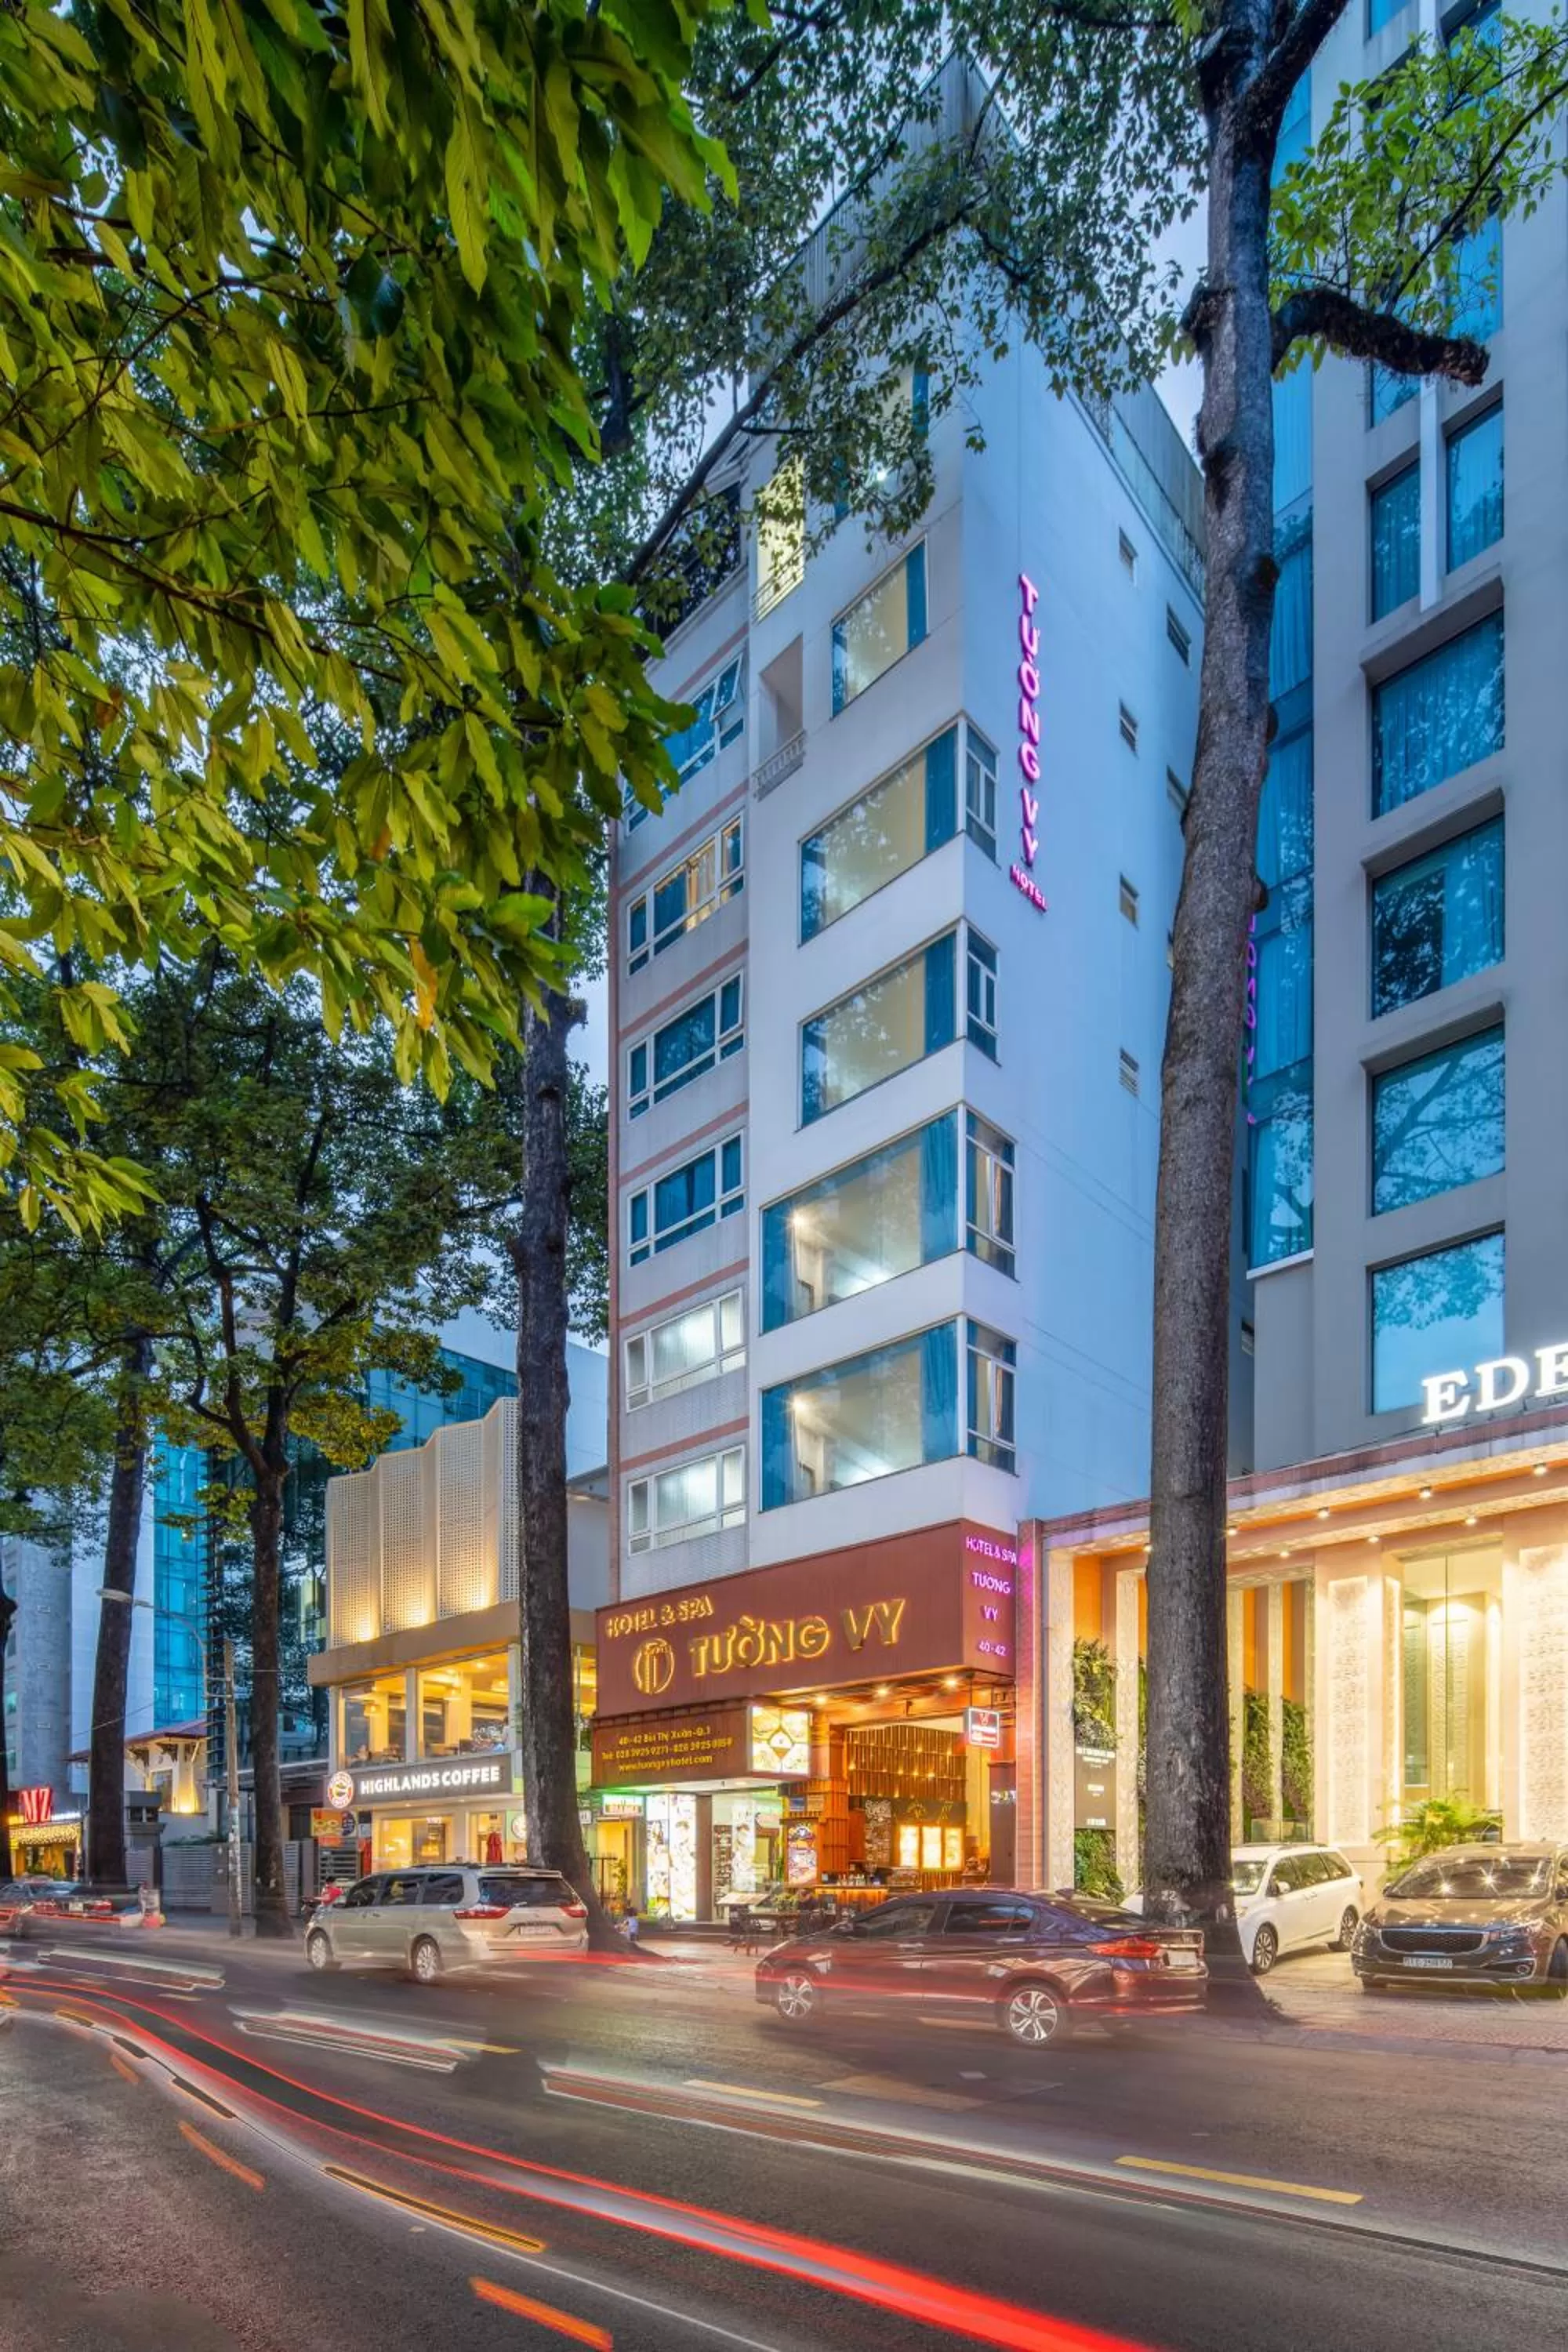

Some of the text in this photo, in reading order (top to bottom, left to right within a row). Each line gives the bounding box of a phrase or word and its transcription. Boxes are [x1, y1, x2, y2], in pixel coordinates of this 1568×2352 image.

[1020, 787, 1039, 868] VY
[1011, 865, 1047, 912] HOTEL
[966, 1536, 993, 1556] HOTEL
[1002, 1548, 1017, 1565] SPA
[606, 1595, 713, 1638] HOTEL & SPA
[984, 1605, 998, 1622] VY
[689, 1598, 906, 1677] TƯỜNG VY
[361, 1772, 440, 1794] HIGHLANDS
[441, 1766, 500, 1787] COFFEE
